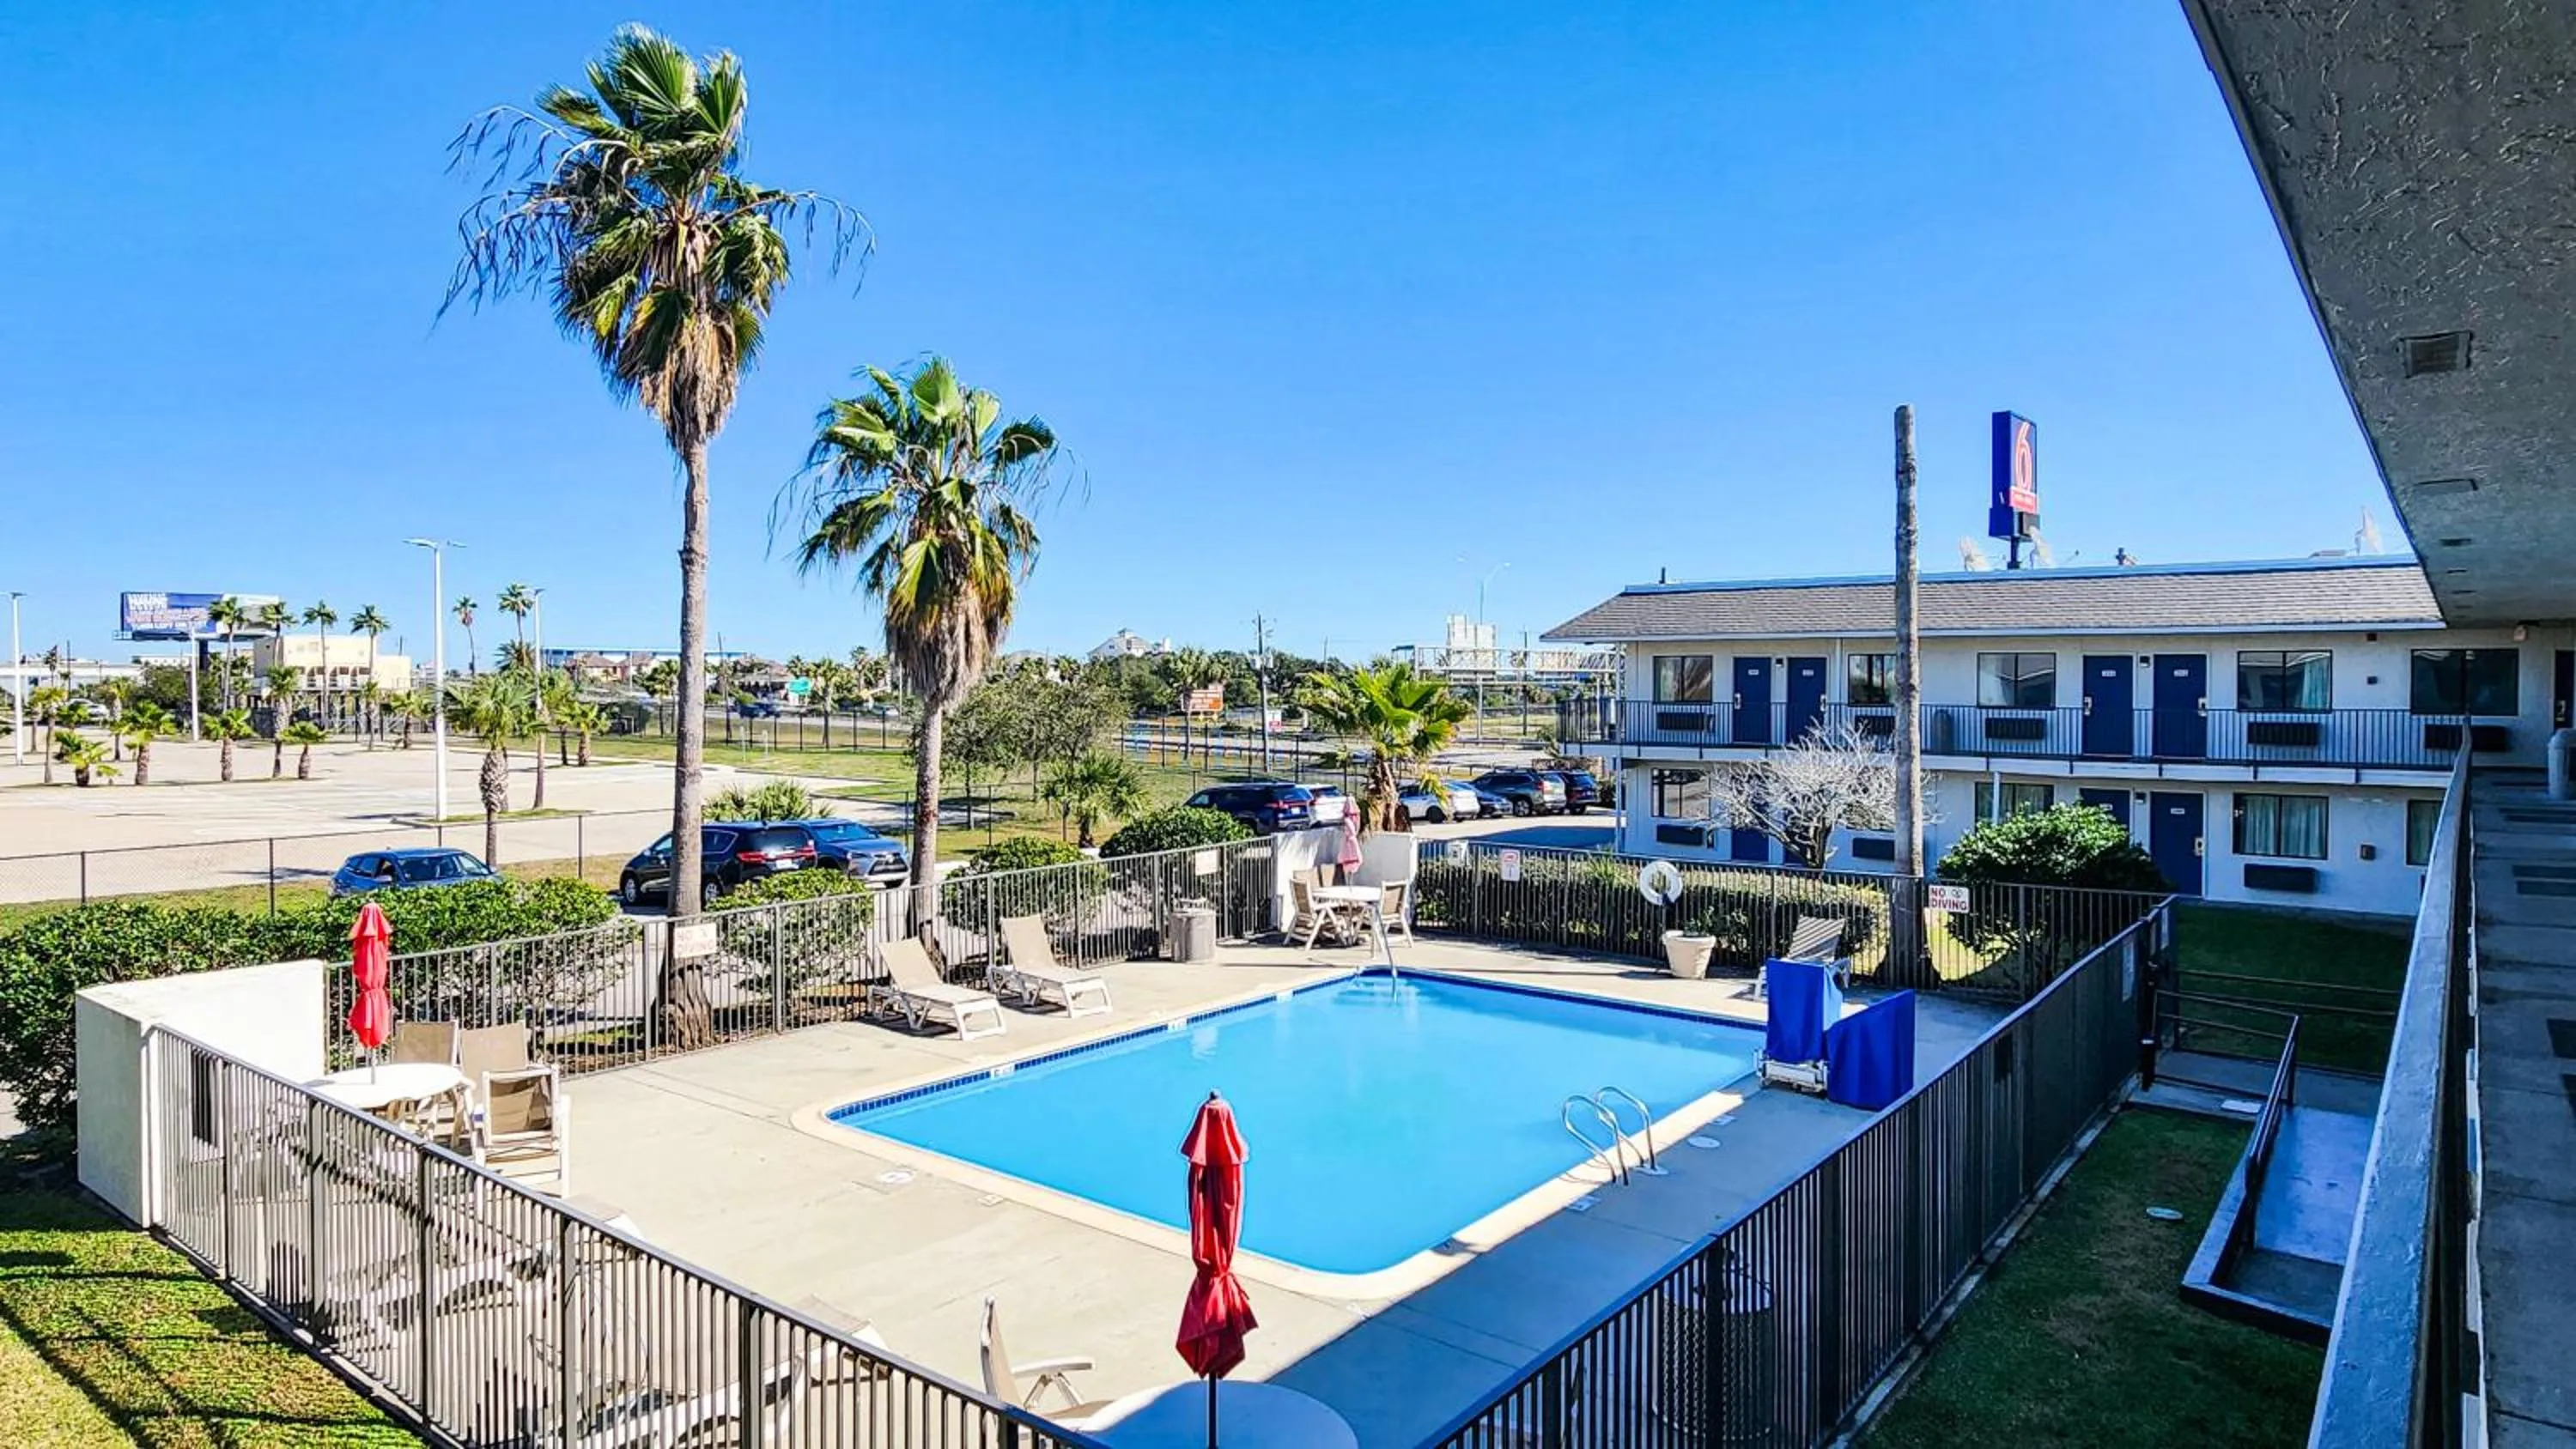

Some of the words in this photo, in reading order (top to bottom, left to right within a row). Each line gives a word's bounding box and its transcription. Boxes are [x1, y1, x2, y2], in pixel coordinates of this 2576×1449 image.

[2016, 421, 2032, 492] 6
[1931, 888, 1946, 898] NO
[1931, 899, 1967, 911] DIVING
